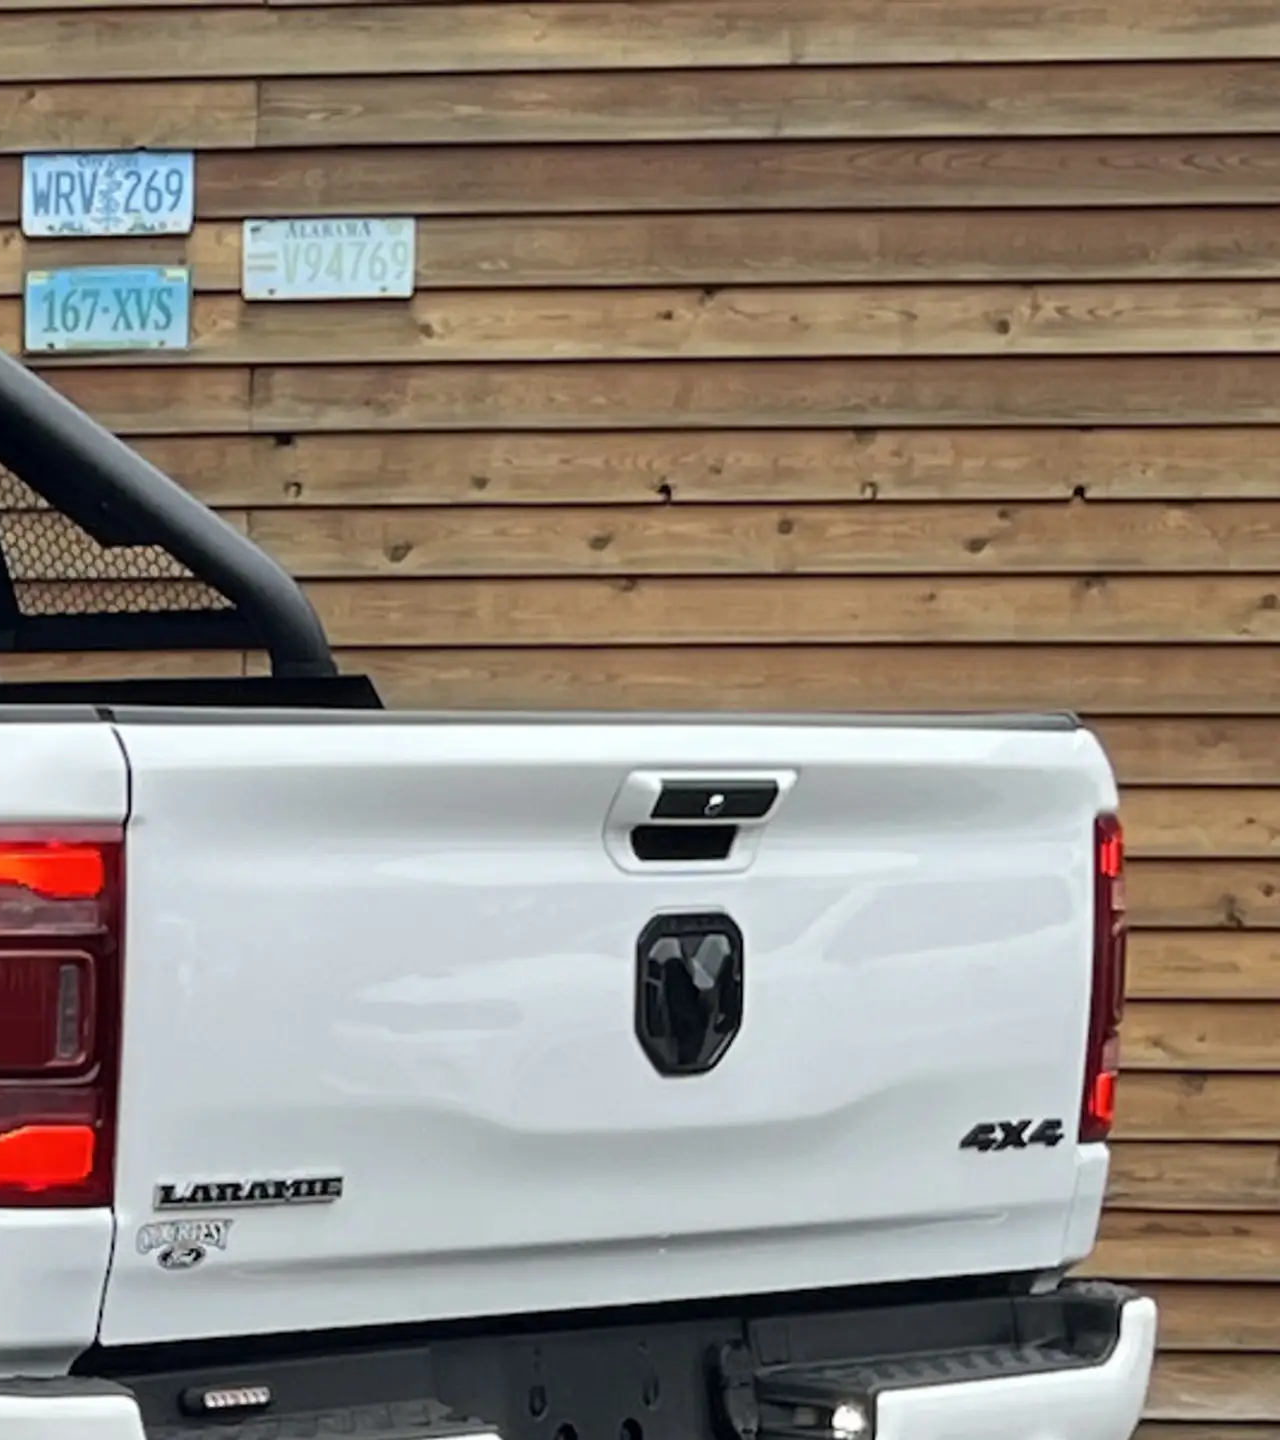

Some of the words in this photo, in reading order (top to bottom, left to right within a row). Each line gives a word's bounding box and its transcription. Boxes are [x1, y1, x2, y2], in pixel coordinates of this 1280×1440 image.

[32, 169, 98, 216] WRV
[123, 168, 184, 213] 269
[157, 1175, 343, 1206] LARAMIE
